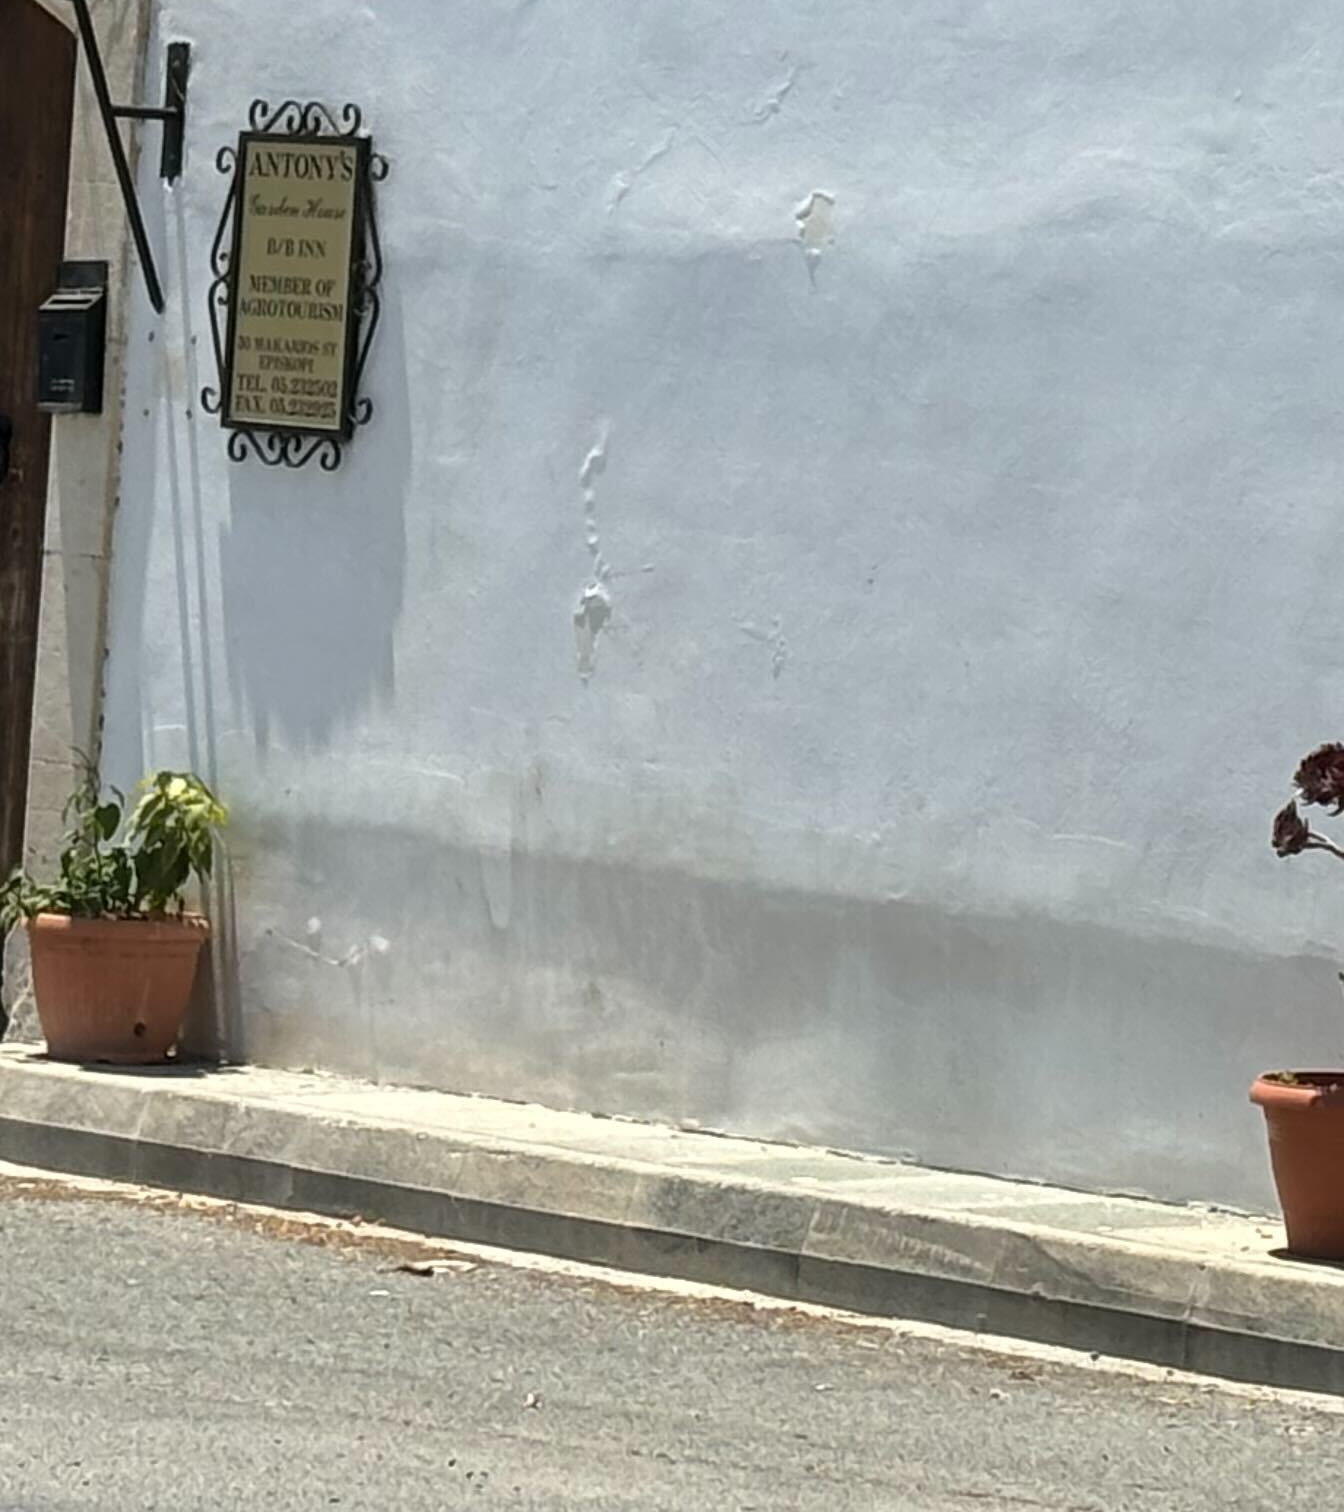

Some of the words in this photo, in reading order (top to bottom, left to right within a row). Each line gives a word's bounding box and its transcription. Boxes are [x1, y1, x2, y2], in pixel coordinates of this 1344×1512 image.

[248, 149, 353, 182] ANTONY'S
[298, 238, 327, 257] INN
[250, 274, 312, 295] MEMBER
[315, 278, 337, 297] OF
[239, 297, 344, 323] AGROTOURISM
